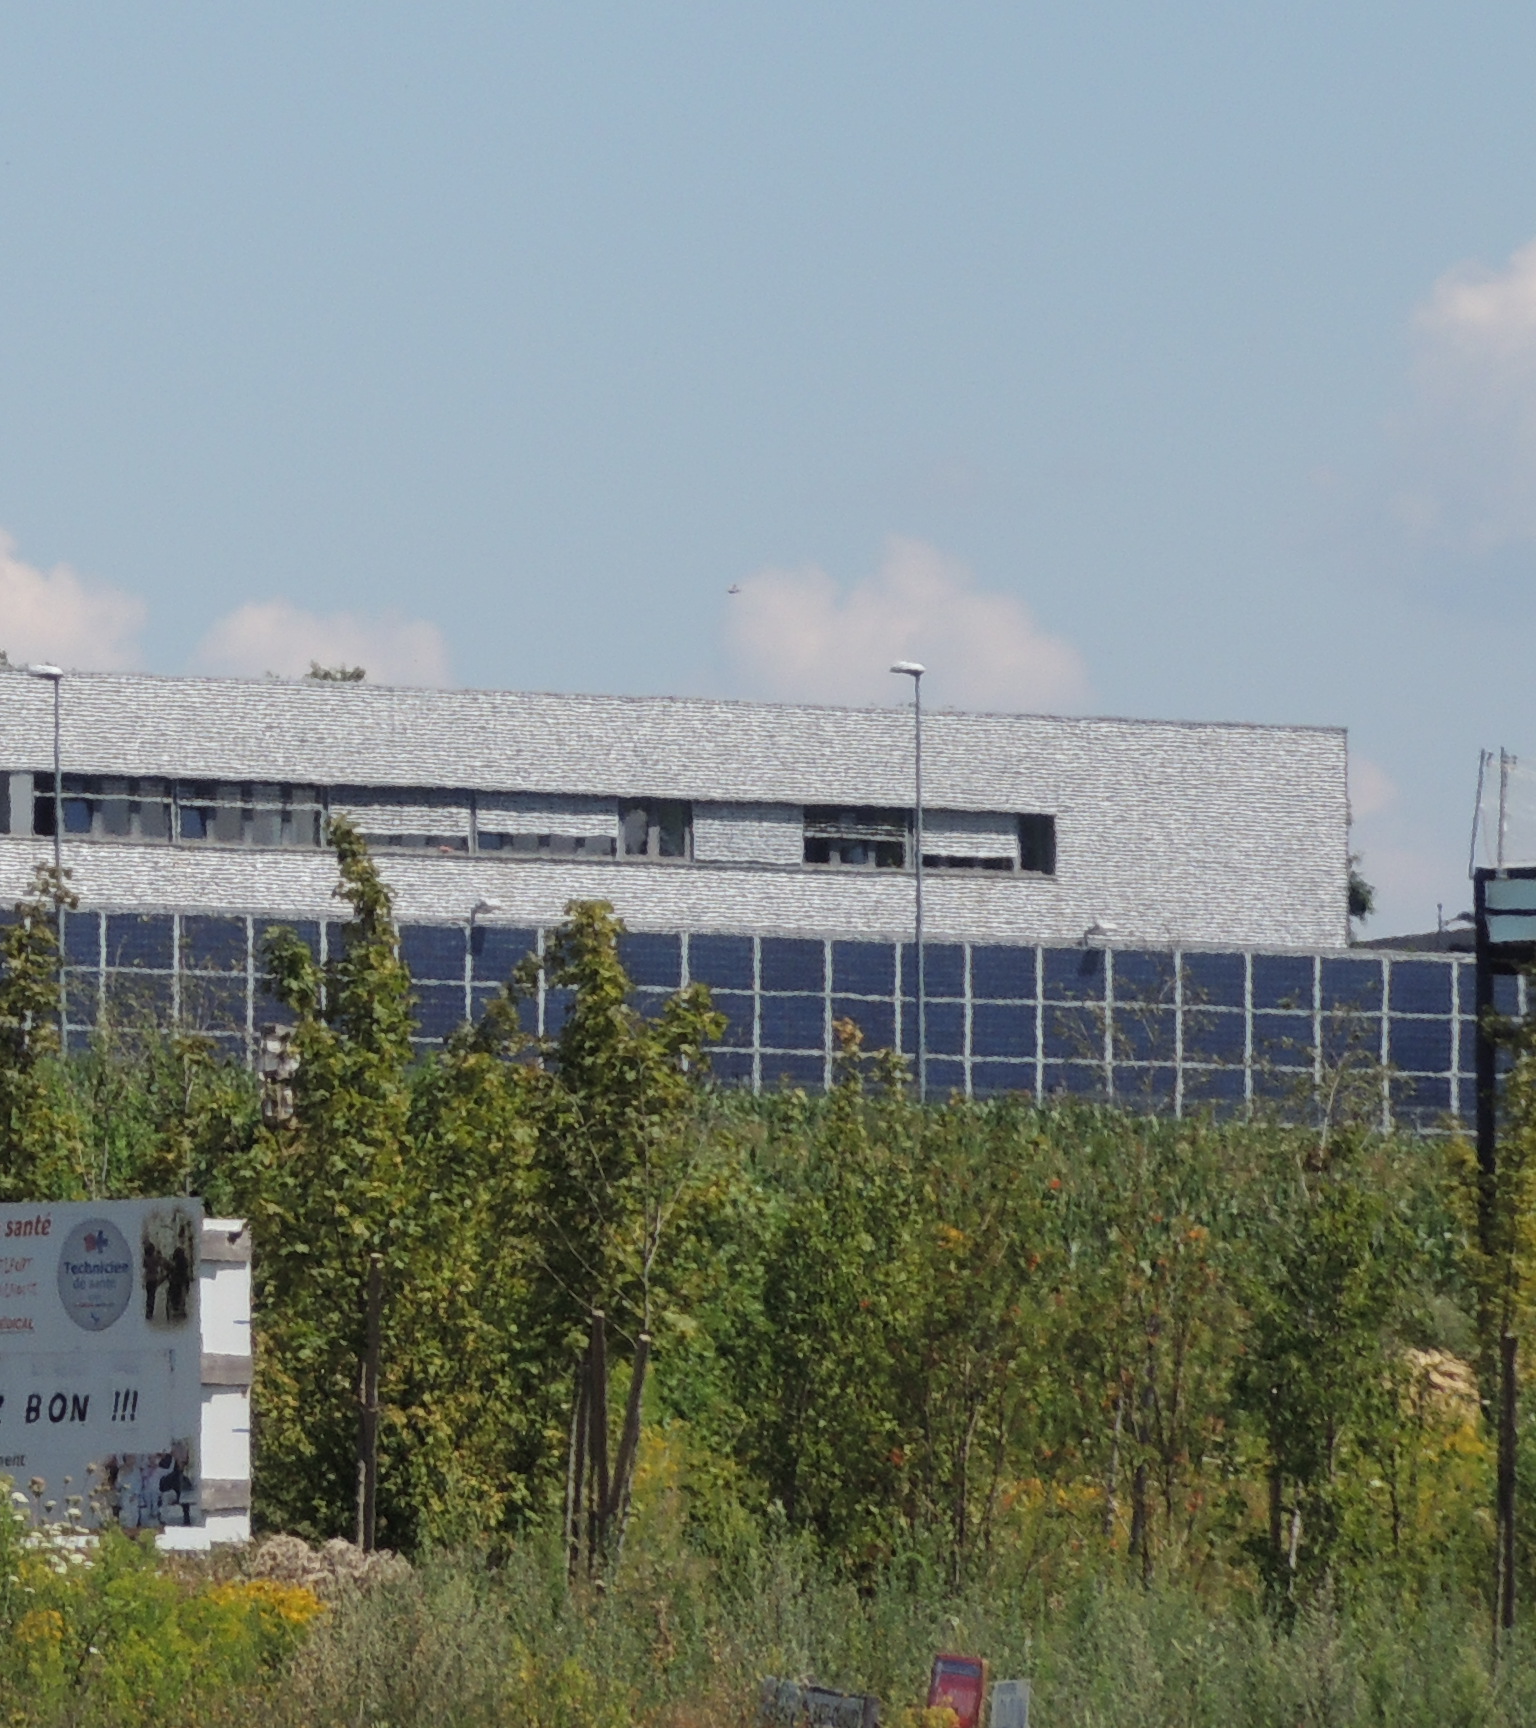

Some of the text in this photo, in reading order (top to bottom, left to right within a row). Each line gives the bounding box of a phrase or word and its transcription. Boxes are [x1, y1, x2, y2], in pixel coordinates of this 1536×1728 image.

[4, 1212, 52, 1238] santé
[63, 1261, 129, 1275] Technicien
[25, 1392, 90, 1424] BON
[111, 1389, 139, 1422] !!!
